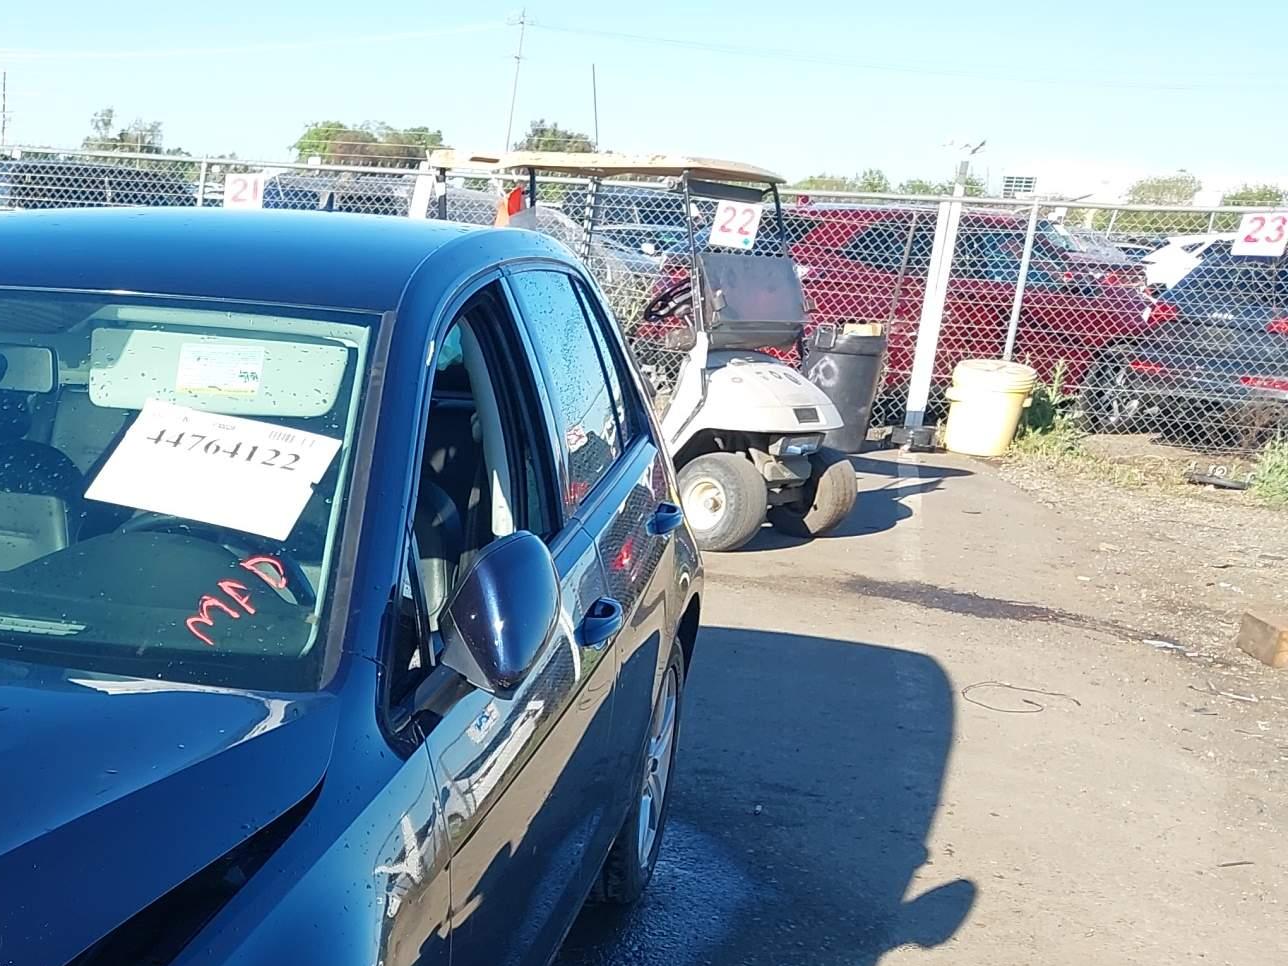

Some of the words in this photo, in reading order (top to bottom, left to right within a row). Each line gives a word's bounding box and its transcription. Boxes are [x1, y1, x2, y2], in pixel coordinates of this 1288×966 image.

[230, 177, 258, 202] 21
[720, 205, 755, 235] 22
[1243, 215, 1287, 243] 23
[146, 428, 301, 471] 44764122
